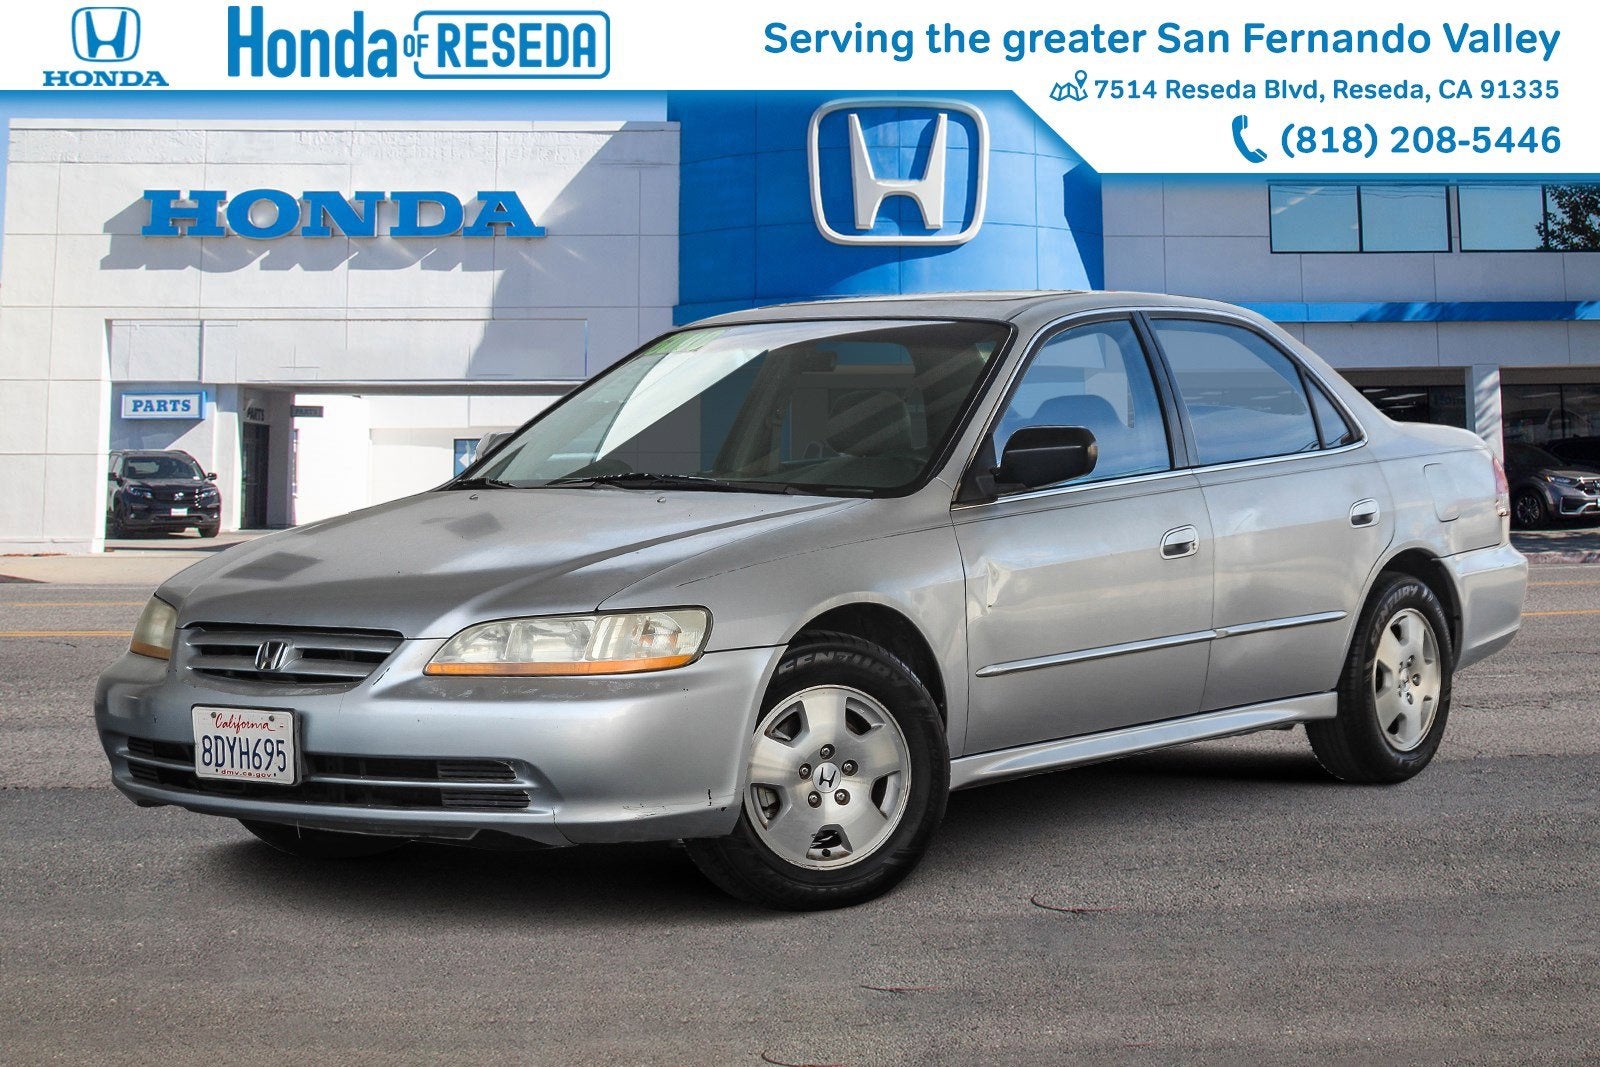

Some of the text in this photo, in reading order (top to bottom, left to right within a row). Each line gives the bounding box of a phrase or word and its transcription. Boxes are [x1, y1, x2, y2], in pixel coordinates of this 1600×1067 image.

[142, 189, 548, 241] HONDA
[132, 399, 192, 413] PARTS
[215, 713, 276, 734] California
[202, 735, 286, 772] 8DYH695
